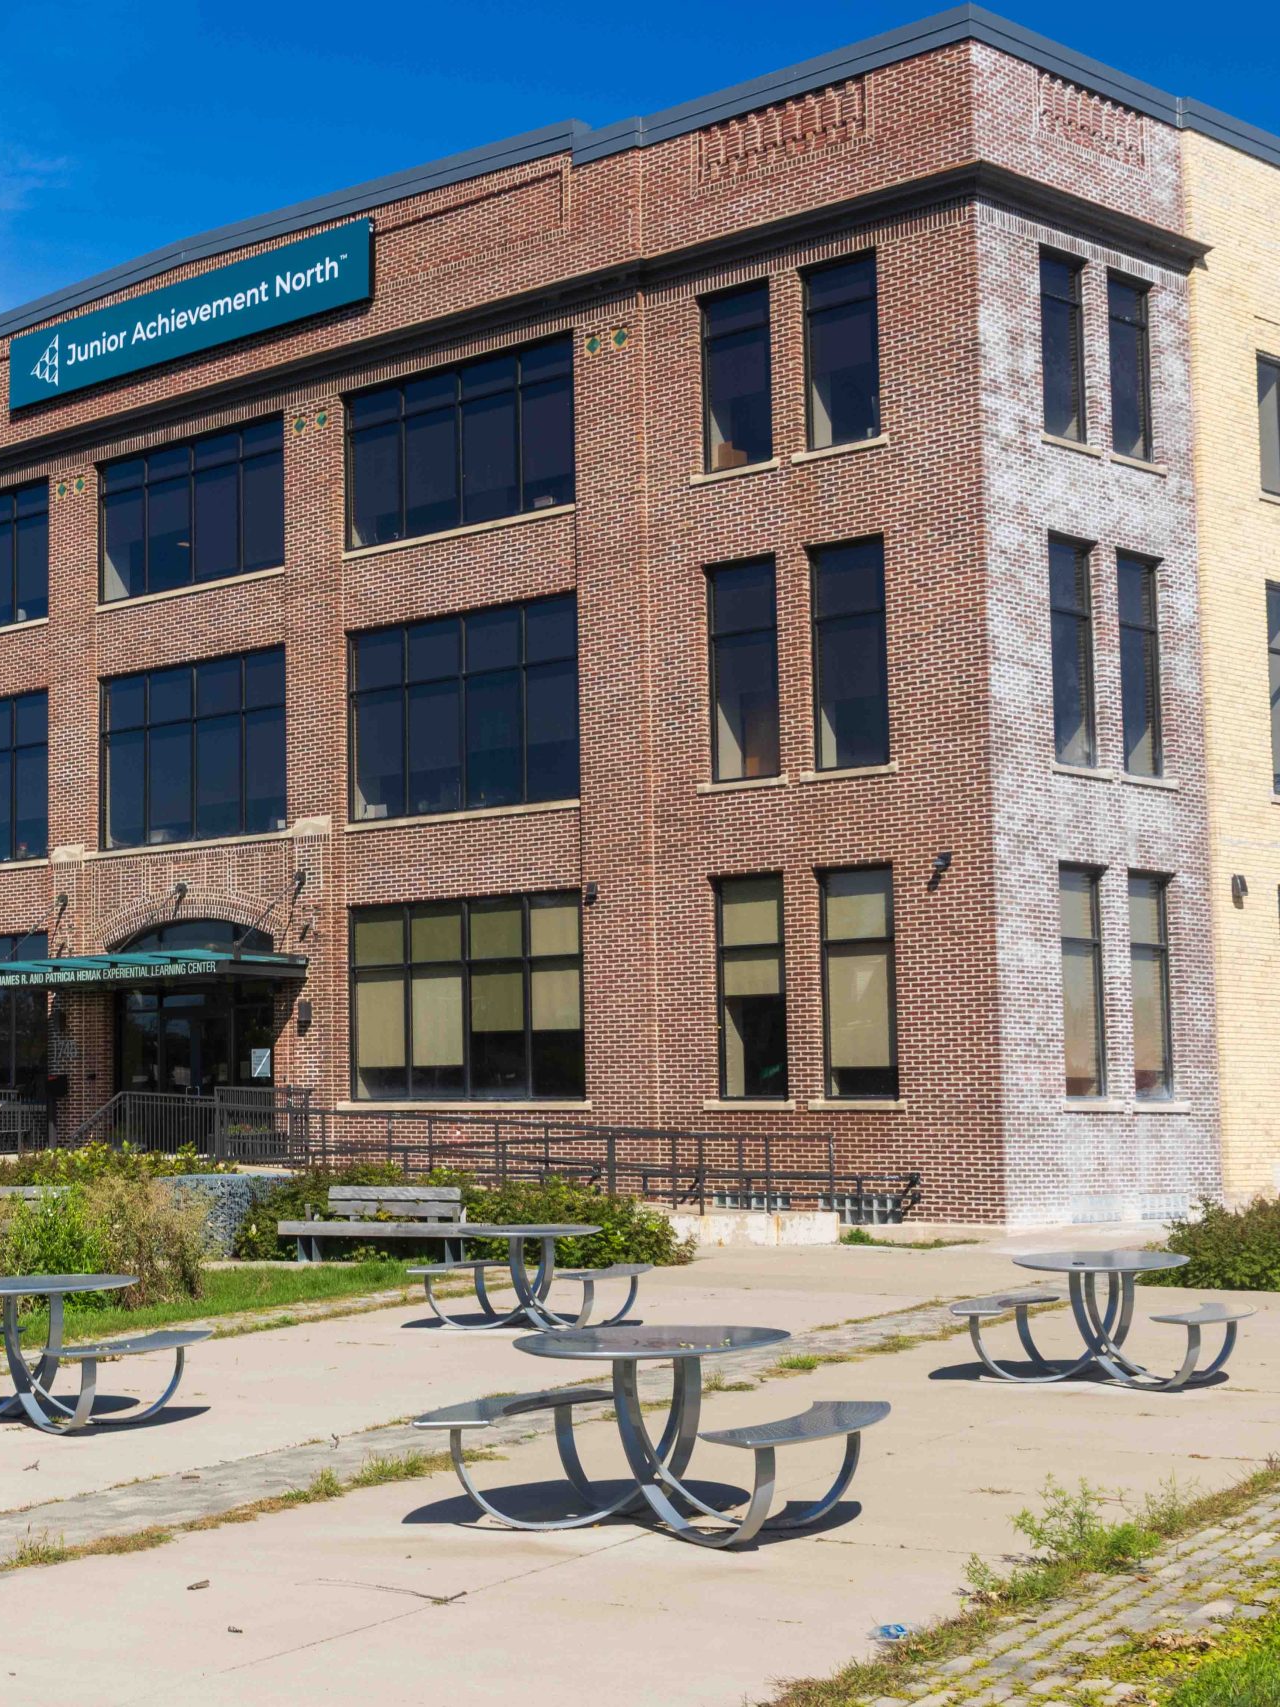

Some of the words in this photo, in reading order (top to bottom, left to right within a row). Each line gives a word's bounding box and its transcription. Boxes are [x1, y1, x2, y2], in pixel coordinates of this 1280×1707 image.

[66, 331, 127, 366] Junior
[131, 281, 269, 345] Achievement
[275, 256, 339, 298] North
[21, 974, 28, 984] R.
[29, 974, 44, 985] AND
[45, 970, 76, 983] PATRICIA
[76, 970, 102, 981] HEMAK
[102, 965, 150, 980] EXPERIENTIAL
[150, 962, 187, 977] LEARNING
[187, 961, 216, 974] CENTER
